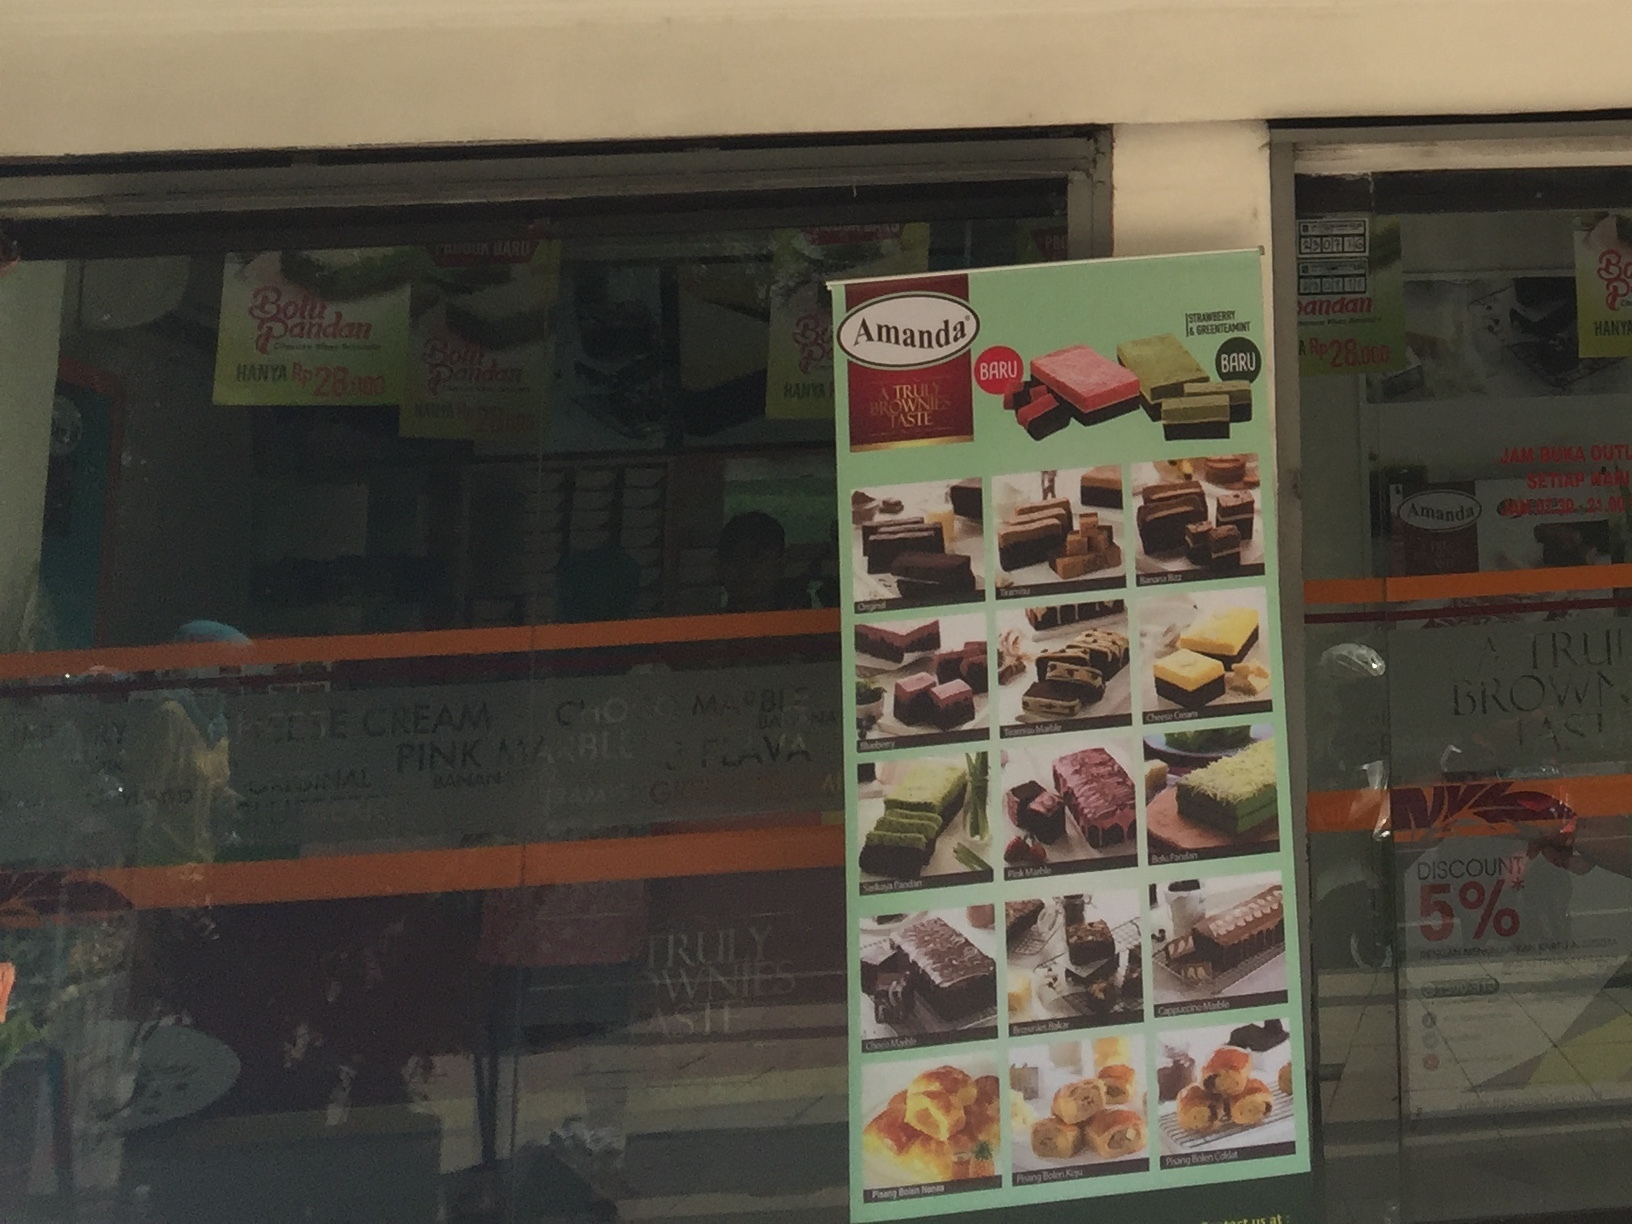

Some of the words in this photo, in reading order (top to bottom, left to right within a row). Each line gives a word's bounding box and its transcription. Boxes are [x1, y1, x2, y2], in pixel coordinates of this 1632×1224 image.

[1297, 297, 1373, 316] andan
[1188, 310, 1236, 323] STRAWBERRY
[255, 311, 373, 355] Pandan
[853, 317, 967, 349] Amanda
[980, 360, 1018, 381] BARU
[1220, 352, 1256, 373] BARU
[893, 381, 940, 399] TRULY
[870, 397, 951, 416] BROWNIES
[890, 412, 934, 428] TASTE
[1539, 445, 1586, 463] BUKA
[1525, 471, 1585, 489] SETIAP
[1407, 502, 1475, 522] Amanda
[396, 737, 482, 773] PINK
[1417, 855, 1524, 881] DISCOUNT
